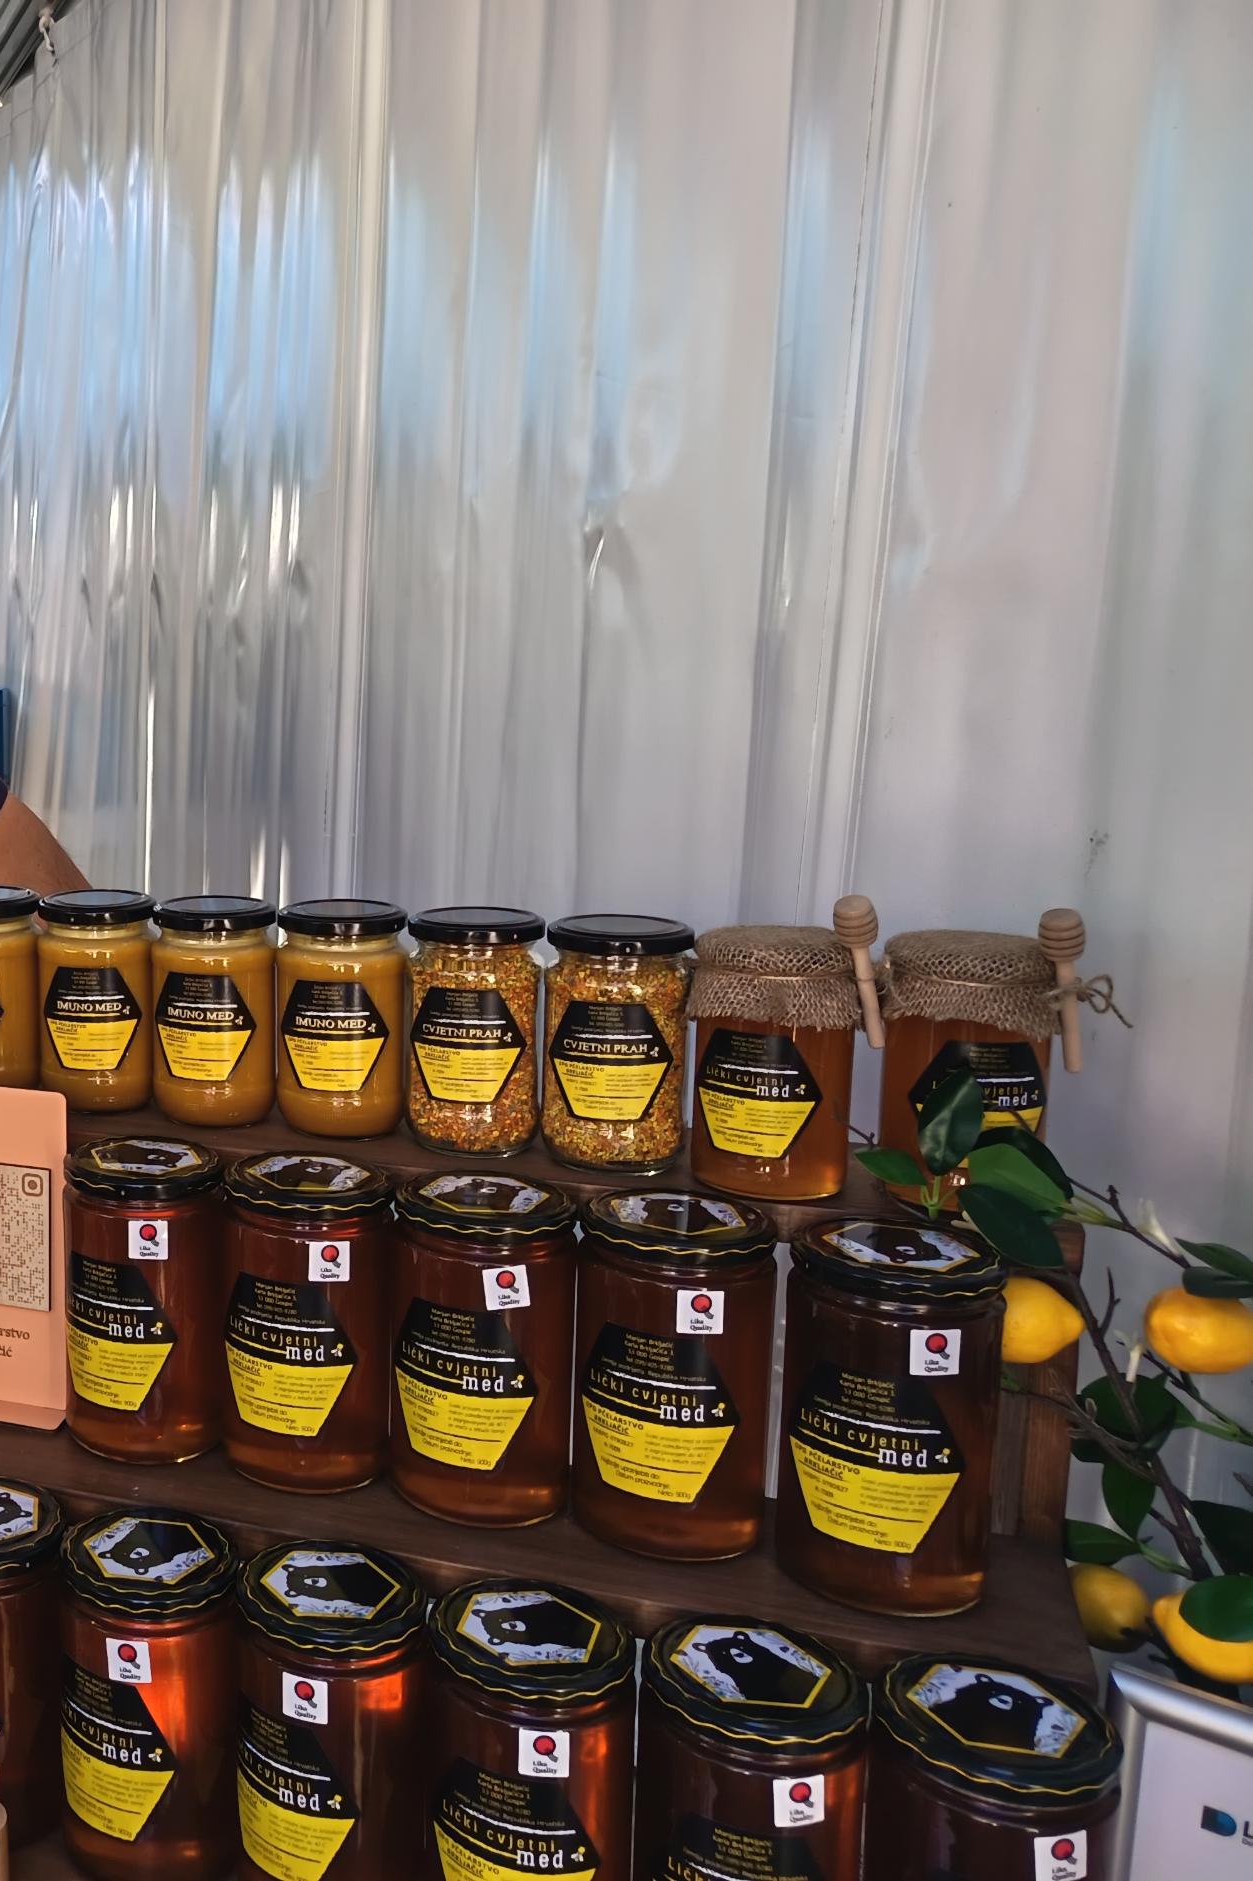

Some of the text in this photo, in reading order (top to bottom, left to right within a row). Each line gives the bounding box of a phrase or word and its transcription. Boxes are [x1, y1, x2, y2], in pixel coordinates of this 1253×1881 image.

[57, 1001, 122, 1012] IMUNO MED
[167, 1007, 235, 1021] IMUNO MED
[295, 1016, 367, 1029] IMUNO MED
[423, 1023, 502, 1038] CVJETNI PRAH
[563, 1039, 648, 1054] CVJETNI PRAH
[707, 1066, 784, 1086] Lički cvjetni
[756, 1085, 790, 1098] med
[982, 1086, 1024, 1097] vjetni
[998, 1092, 1028, 1107] med
[89, 1307, 137, 1325] cvjetni
[109, 1322, 145, 1340] med
[230, 1315, 318, 1347] Lički cvjetni
[690, 1324, 713, 1332] Quality
[286, 1345, 325, 1362] med
[402, 1340, 430, 1365] Lički
[437, 1359, 497, 1377] cvjetni
[462, 1376, 504, 1393] med
[590, 1368, 697, 1407] Lički cvjetni
[660, 1404, 705, 1423] med
[800, 1408, 919, 1450] Lički cvjetni
[878, 1449, 928, 1468] med
[295, 1710, 317, 1721] Quality
[81, 1722, 135, 1749] cvjetni
[103, 1742, 142, 1765] med
[257, 1763, 312, 1794] cvjetni
[533, 1766, 558, 1774] Quality
[279, 1787, 321, 1812] med
[443, 1799, 478, 1833] Lički
[487, 1829, 555, 1852] cvjetni
[516, 1849, 564, 1869] med
[668, 1856, 710, 1881] Ličk
